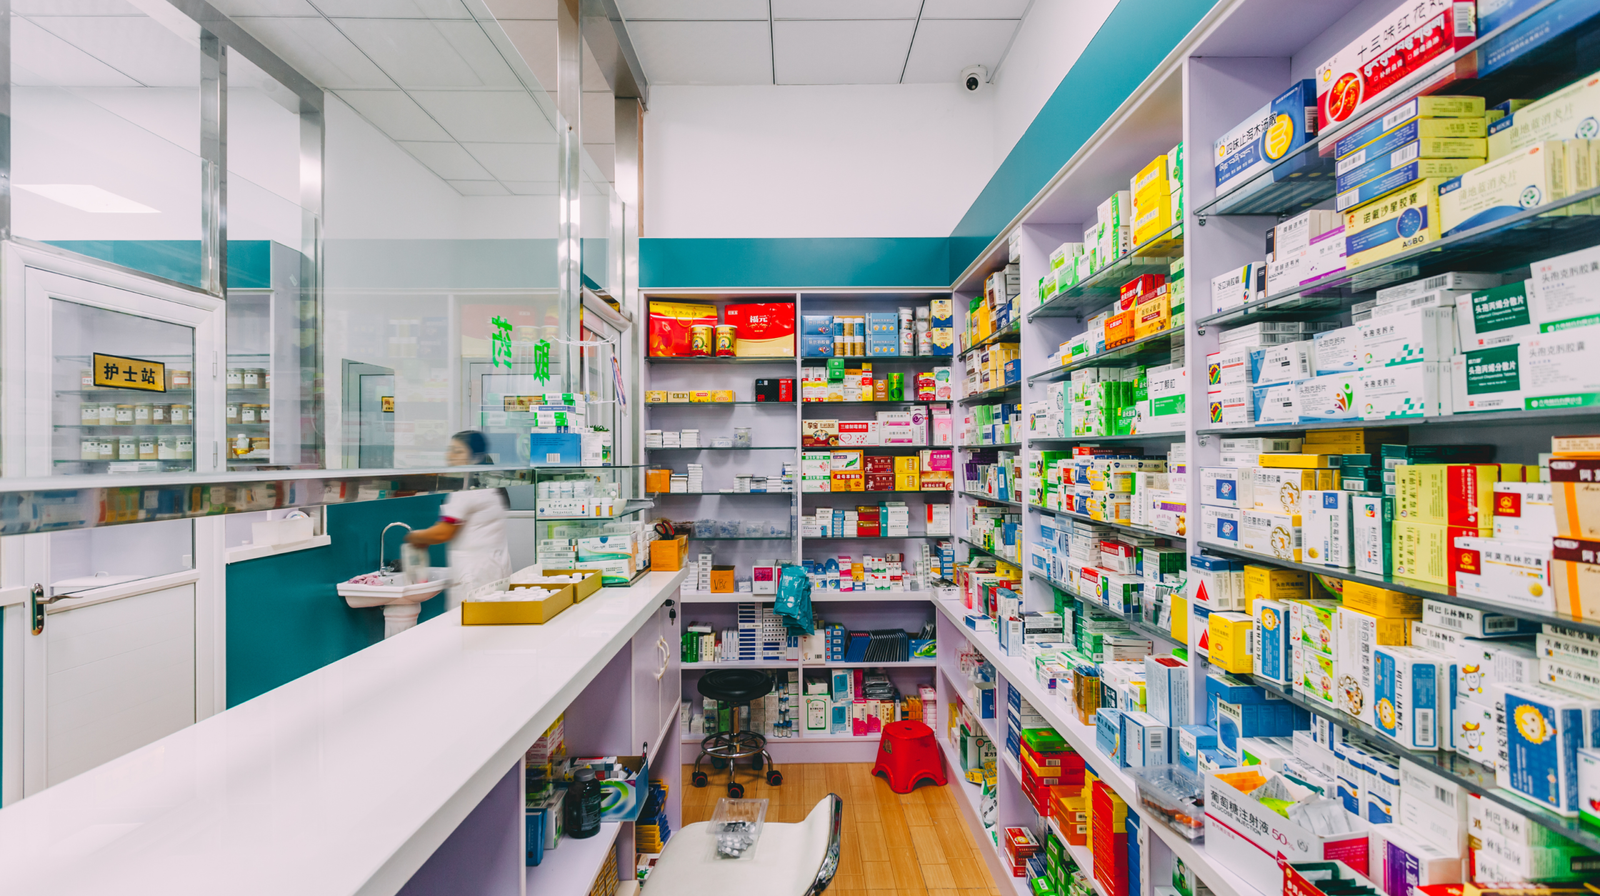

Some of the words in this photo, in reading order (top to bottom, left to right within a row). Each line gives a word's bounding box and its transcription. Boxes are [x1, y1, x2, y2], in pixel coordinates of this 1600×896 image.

[1357, 0, 1444, 63] 十三味红花丸
[1226, 111, 1277, 155] 四味止泻木汤散
[1509, 102, 1575, 140] 蒲地蓝消炎片
[1458, 169, 1518, 202] 蒲地蓝消炎片
[1363, 192, 1418, 224] 诺氟沙星胶囊
[1541, 261, 1600, 283] 头孢克肟胶囊
[1475, 295, 1525, 314] 头孢丙烯分散片
[1318, 336, 1346, 348] 头孢克肟片
[1363, 325, 1395, 338] 头孢克肟片
[1529, 341, 1586, 358] 头孢克肟胶囊
[103, 363, 156, 385] 护士站
[1468, 360, 1517, 375] 头孢丙烯分散片
[1299, 384, 1327, 394] 头孢克肟片
[1364, 378, 1395, 388] 头孢克肟片
[1408, 469, 1417, 518] 青霉素V钾片
[1332, 514, 1340, 563] 阿奇霉素分散片
[1370, 526, 1378, 565] 利巴韦林片
[1407, 526, 1415, 575] 青霉素V钾片
[1485, 551, 1543, 566] 阿莫西林胶囊
[1427, 603, 1474, 622] 利巴韦林颗粒
[1414, 626, 1455, 643] 利巴韦林颗粒
[1361, 618, 1370, 688] 阿奇霉素颗粒
[1545, 639, 1599, 658] 头孢克洛颗粒
[1548, 664, 1600, 685] 头孢克洛颗粒
[1395, 670, 1403, 732] 利巴韦林颗粒
[1495, 700, 1508, 772] 头孢克洛颗粒
[1210, 790, 1270, 836] 葡萄糖注射液
[1211, 802, 1235, 820] GLUCOSE
[1235, 817, 1262, 837] INJECTION
[1485, 807, 1520, 834] 利巴韦林
